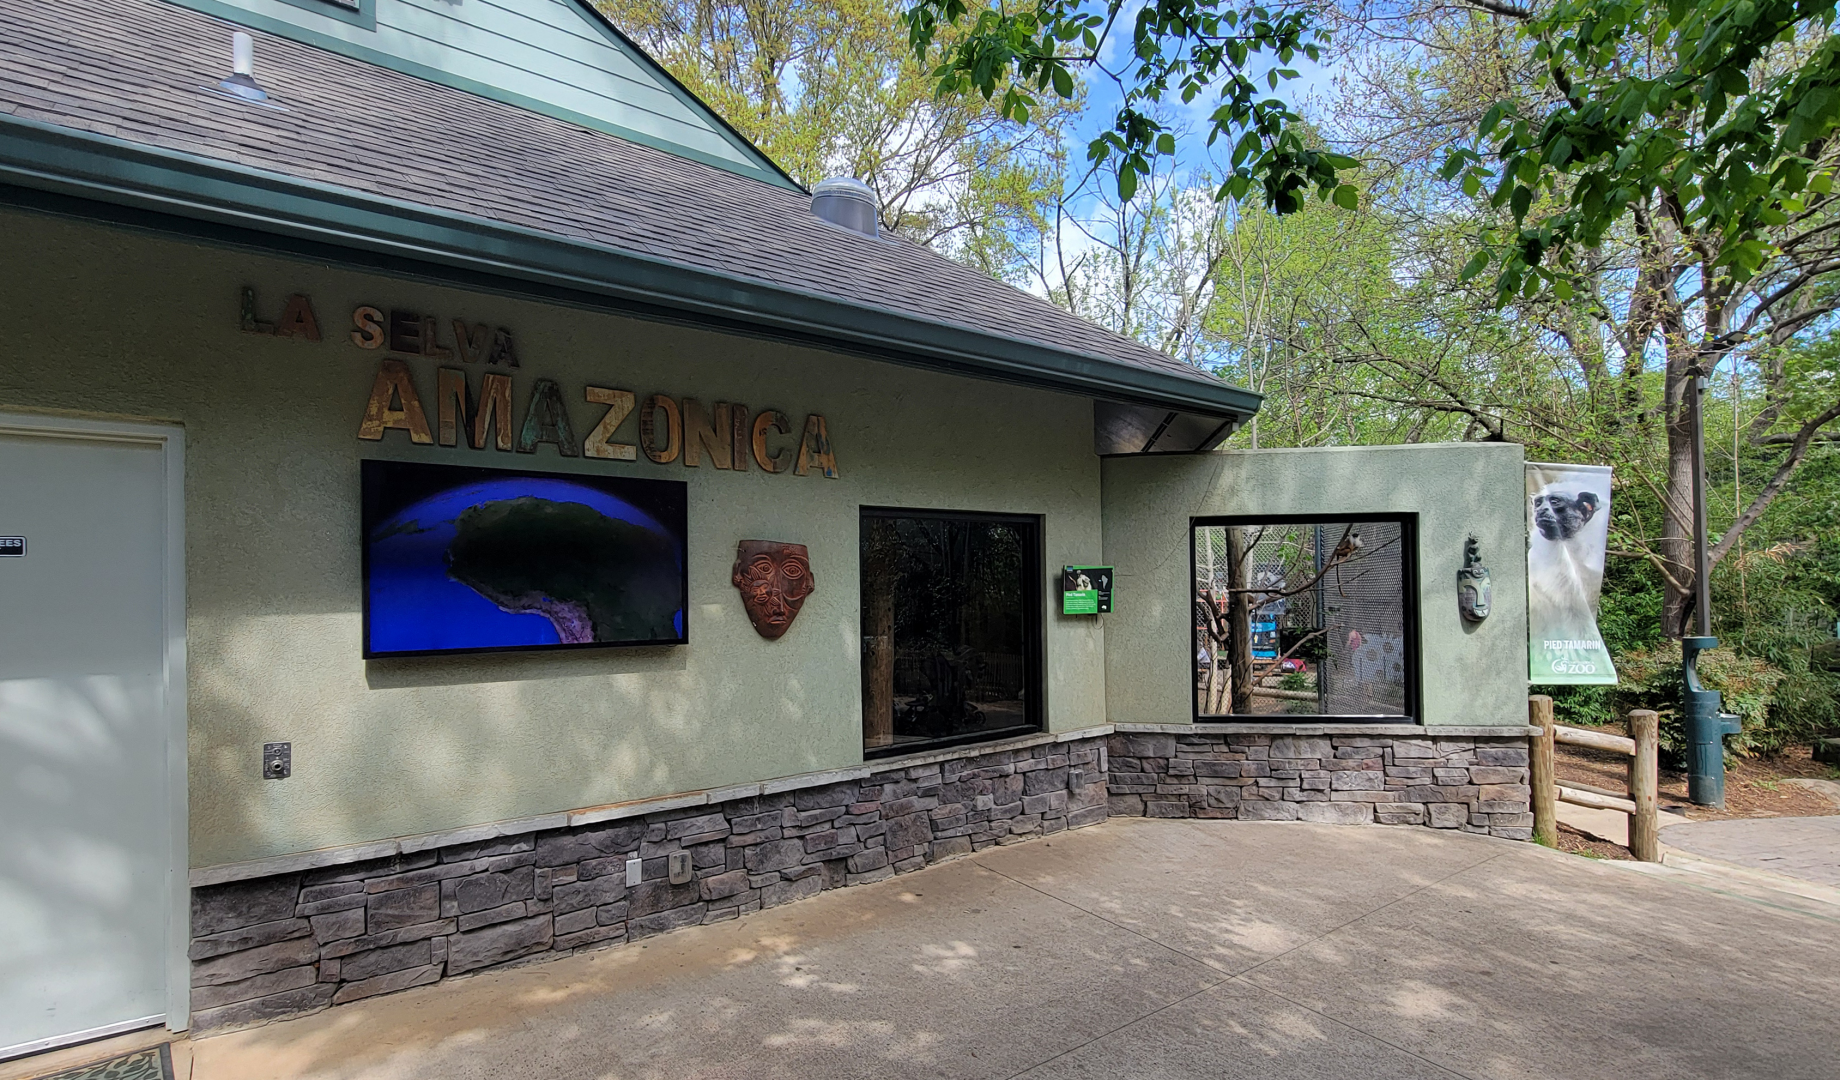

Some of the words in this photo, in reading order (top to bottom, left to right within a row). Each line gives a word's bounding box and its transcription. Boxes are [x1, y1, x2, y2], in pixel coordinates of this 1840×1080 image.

[241, 288, 321, 342] LA
[351, 305, 520, 369] SELVA
[357, 359, 839, 479] AMAZONICA
[1544, 640, 1562, 650] PIED
[1564, 640, 1600, 650] TAMARIN
[1568, 664, 1595, 674] ZOO
